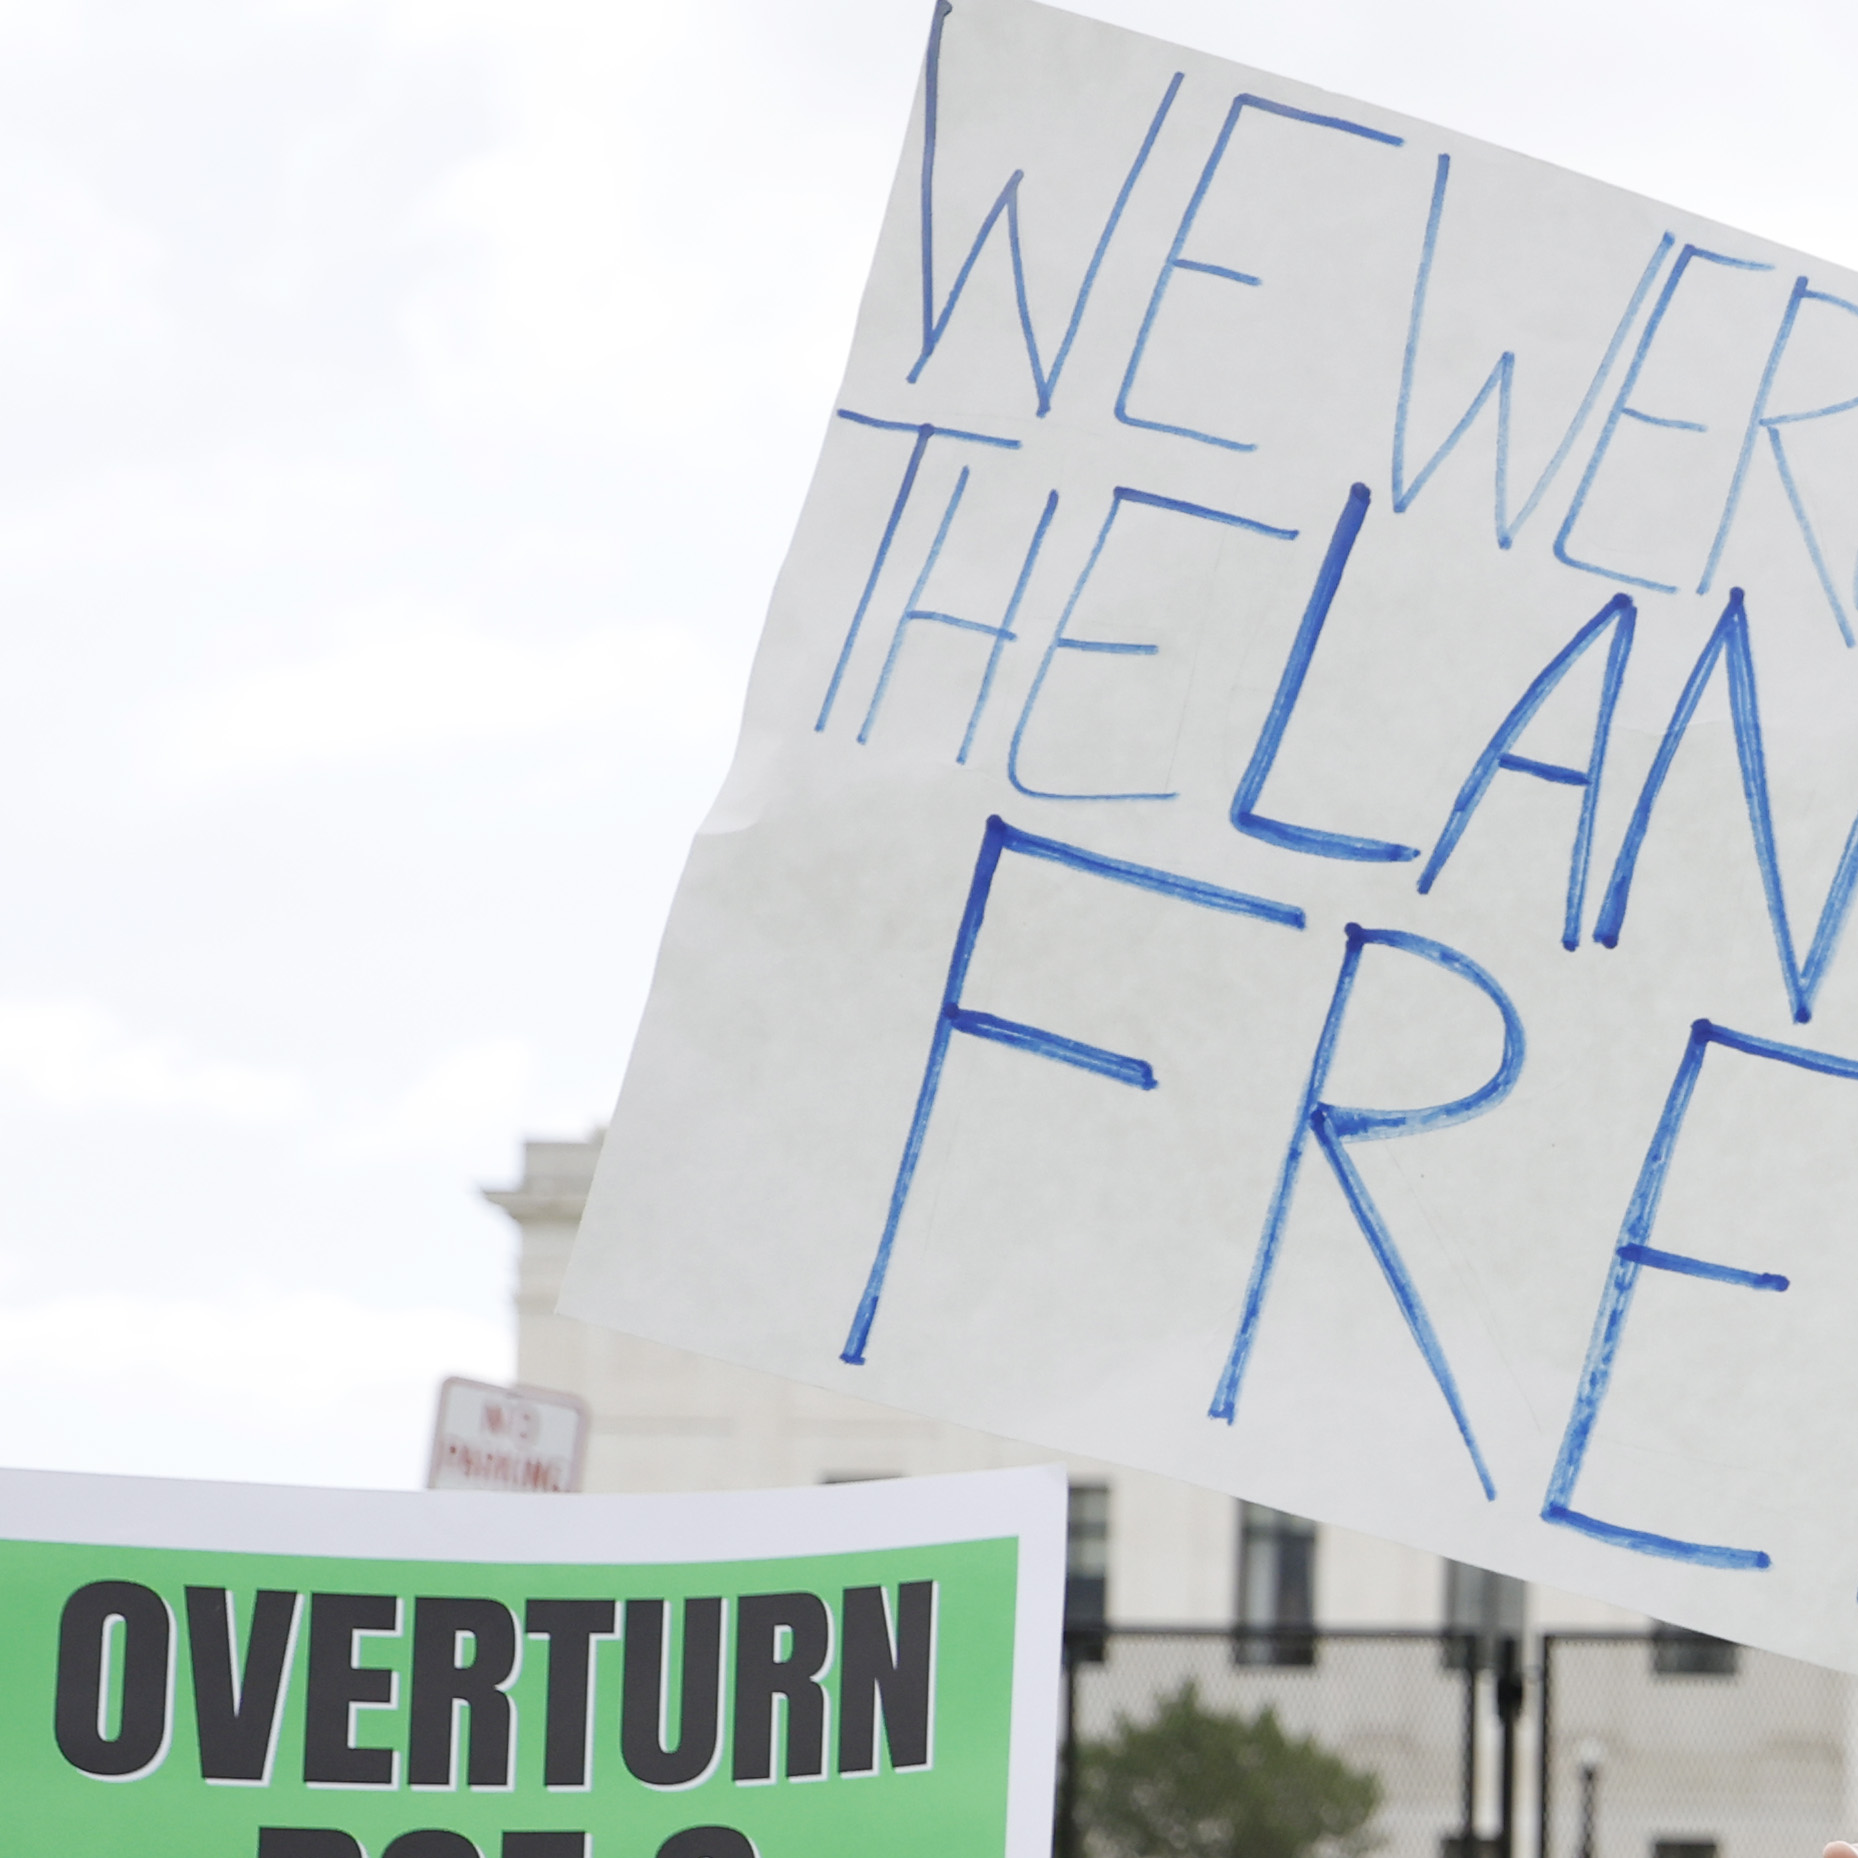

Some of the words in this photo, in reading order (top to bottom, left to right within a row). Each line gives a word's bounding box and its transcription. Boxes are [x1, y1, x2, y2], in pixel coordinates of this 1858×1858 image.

[907, 0, 1404, 452] WE
[814, 407, 1300, 802] THE
[52, 1577, 938, 1790] OVERTURN
